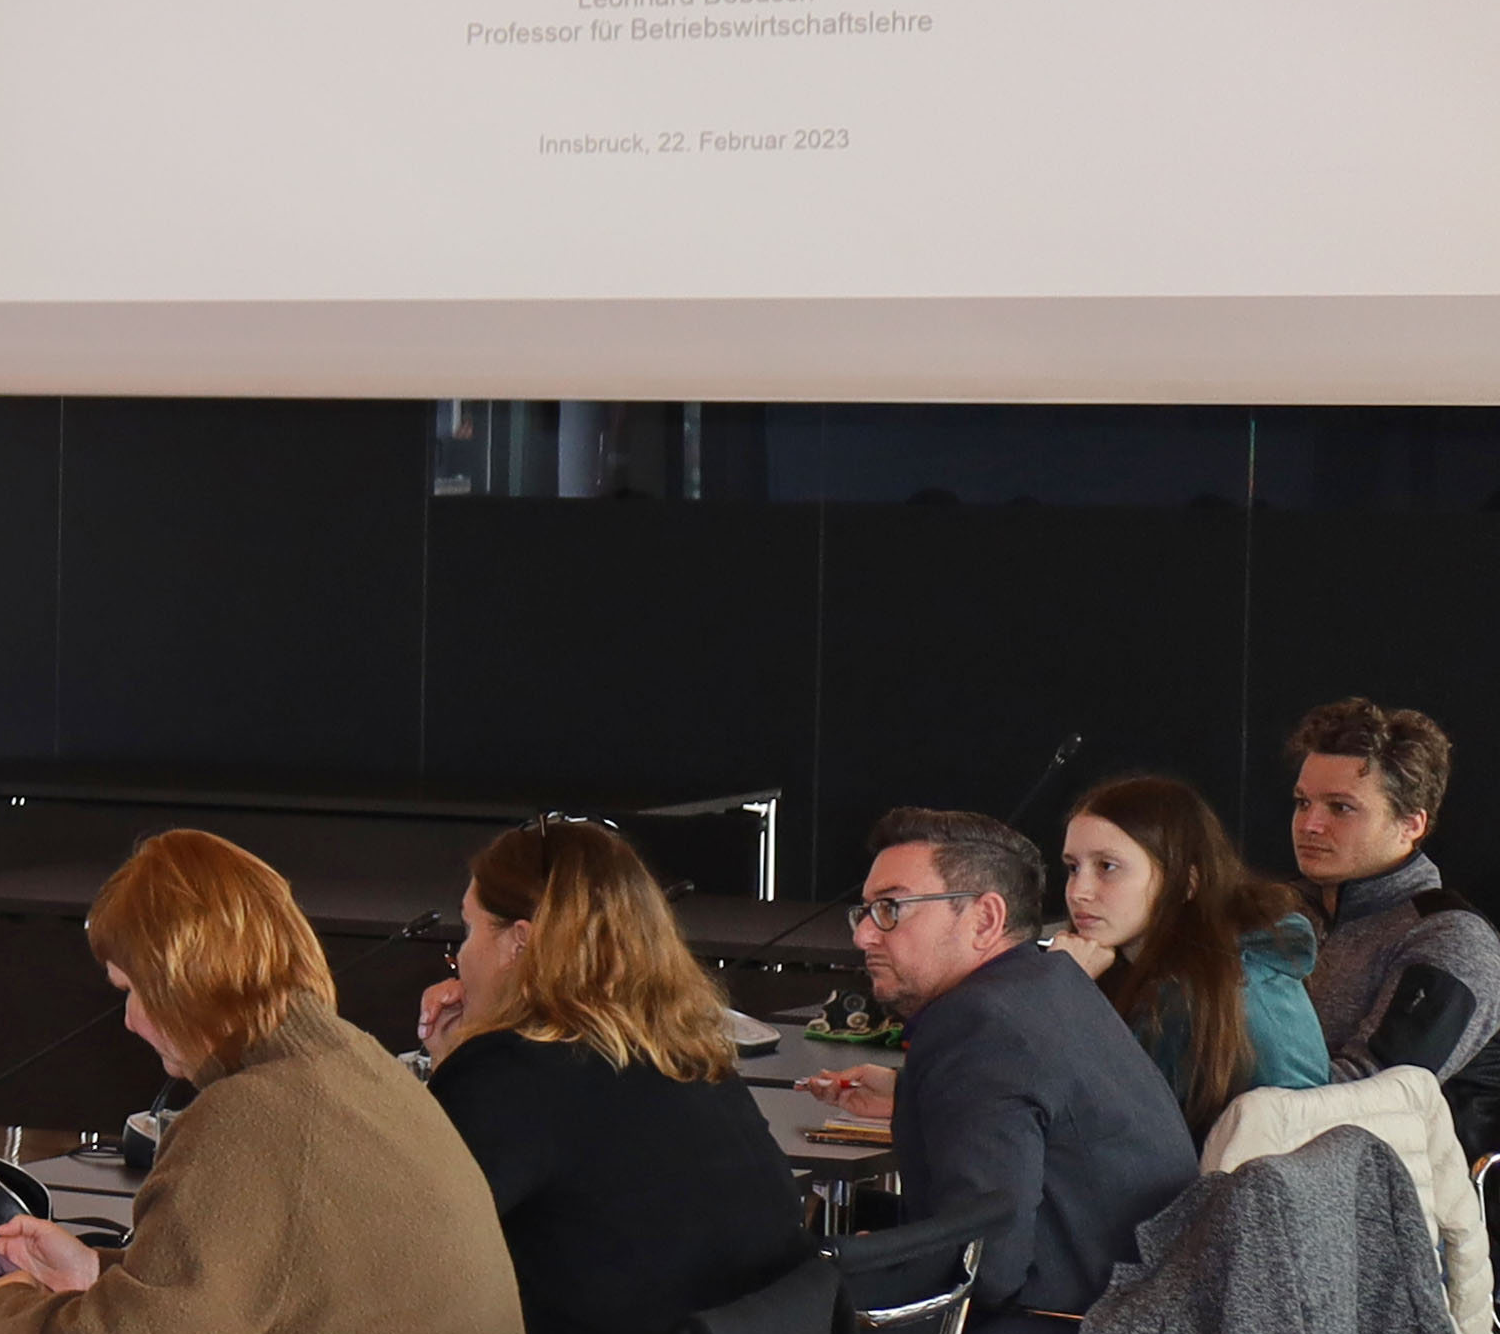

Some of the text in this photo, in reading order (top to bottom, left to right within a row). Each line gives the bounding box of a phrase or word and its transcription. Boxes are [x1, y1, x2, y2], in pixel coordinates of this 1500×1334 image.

[466, 10, 934, 45] Professor für Betriebswirtschaftslehre
[538, 128, 851, 156] Innsbruck, 22. Februar 2023
